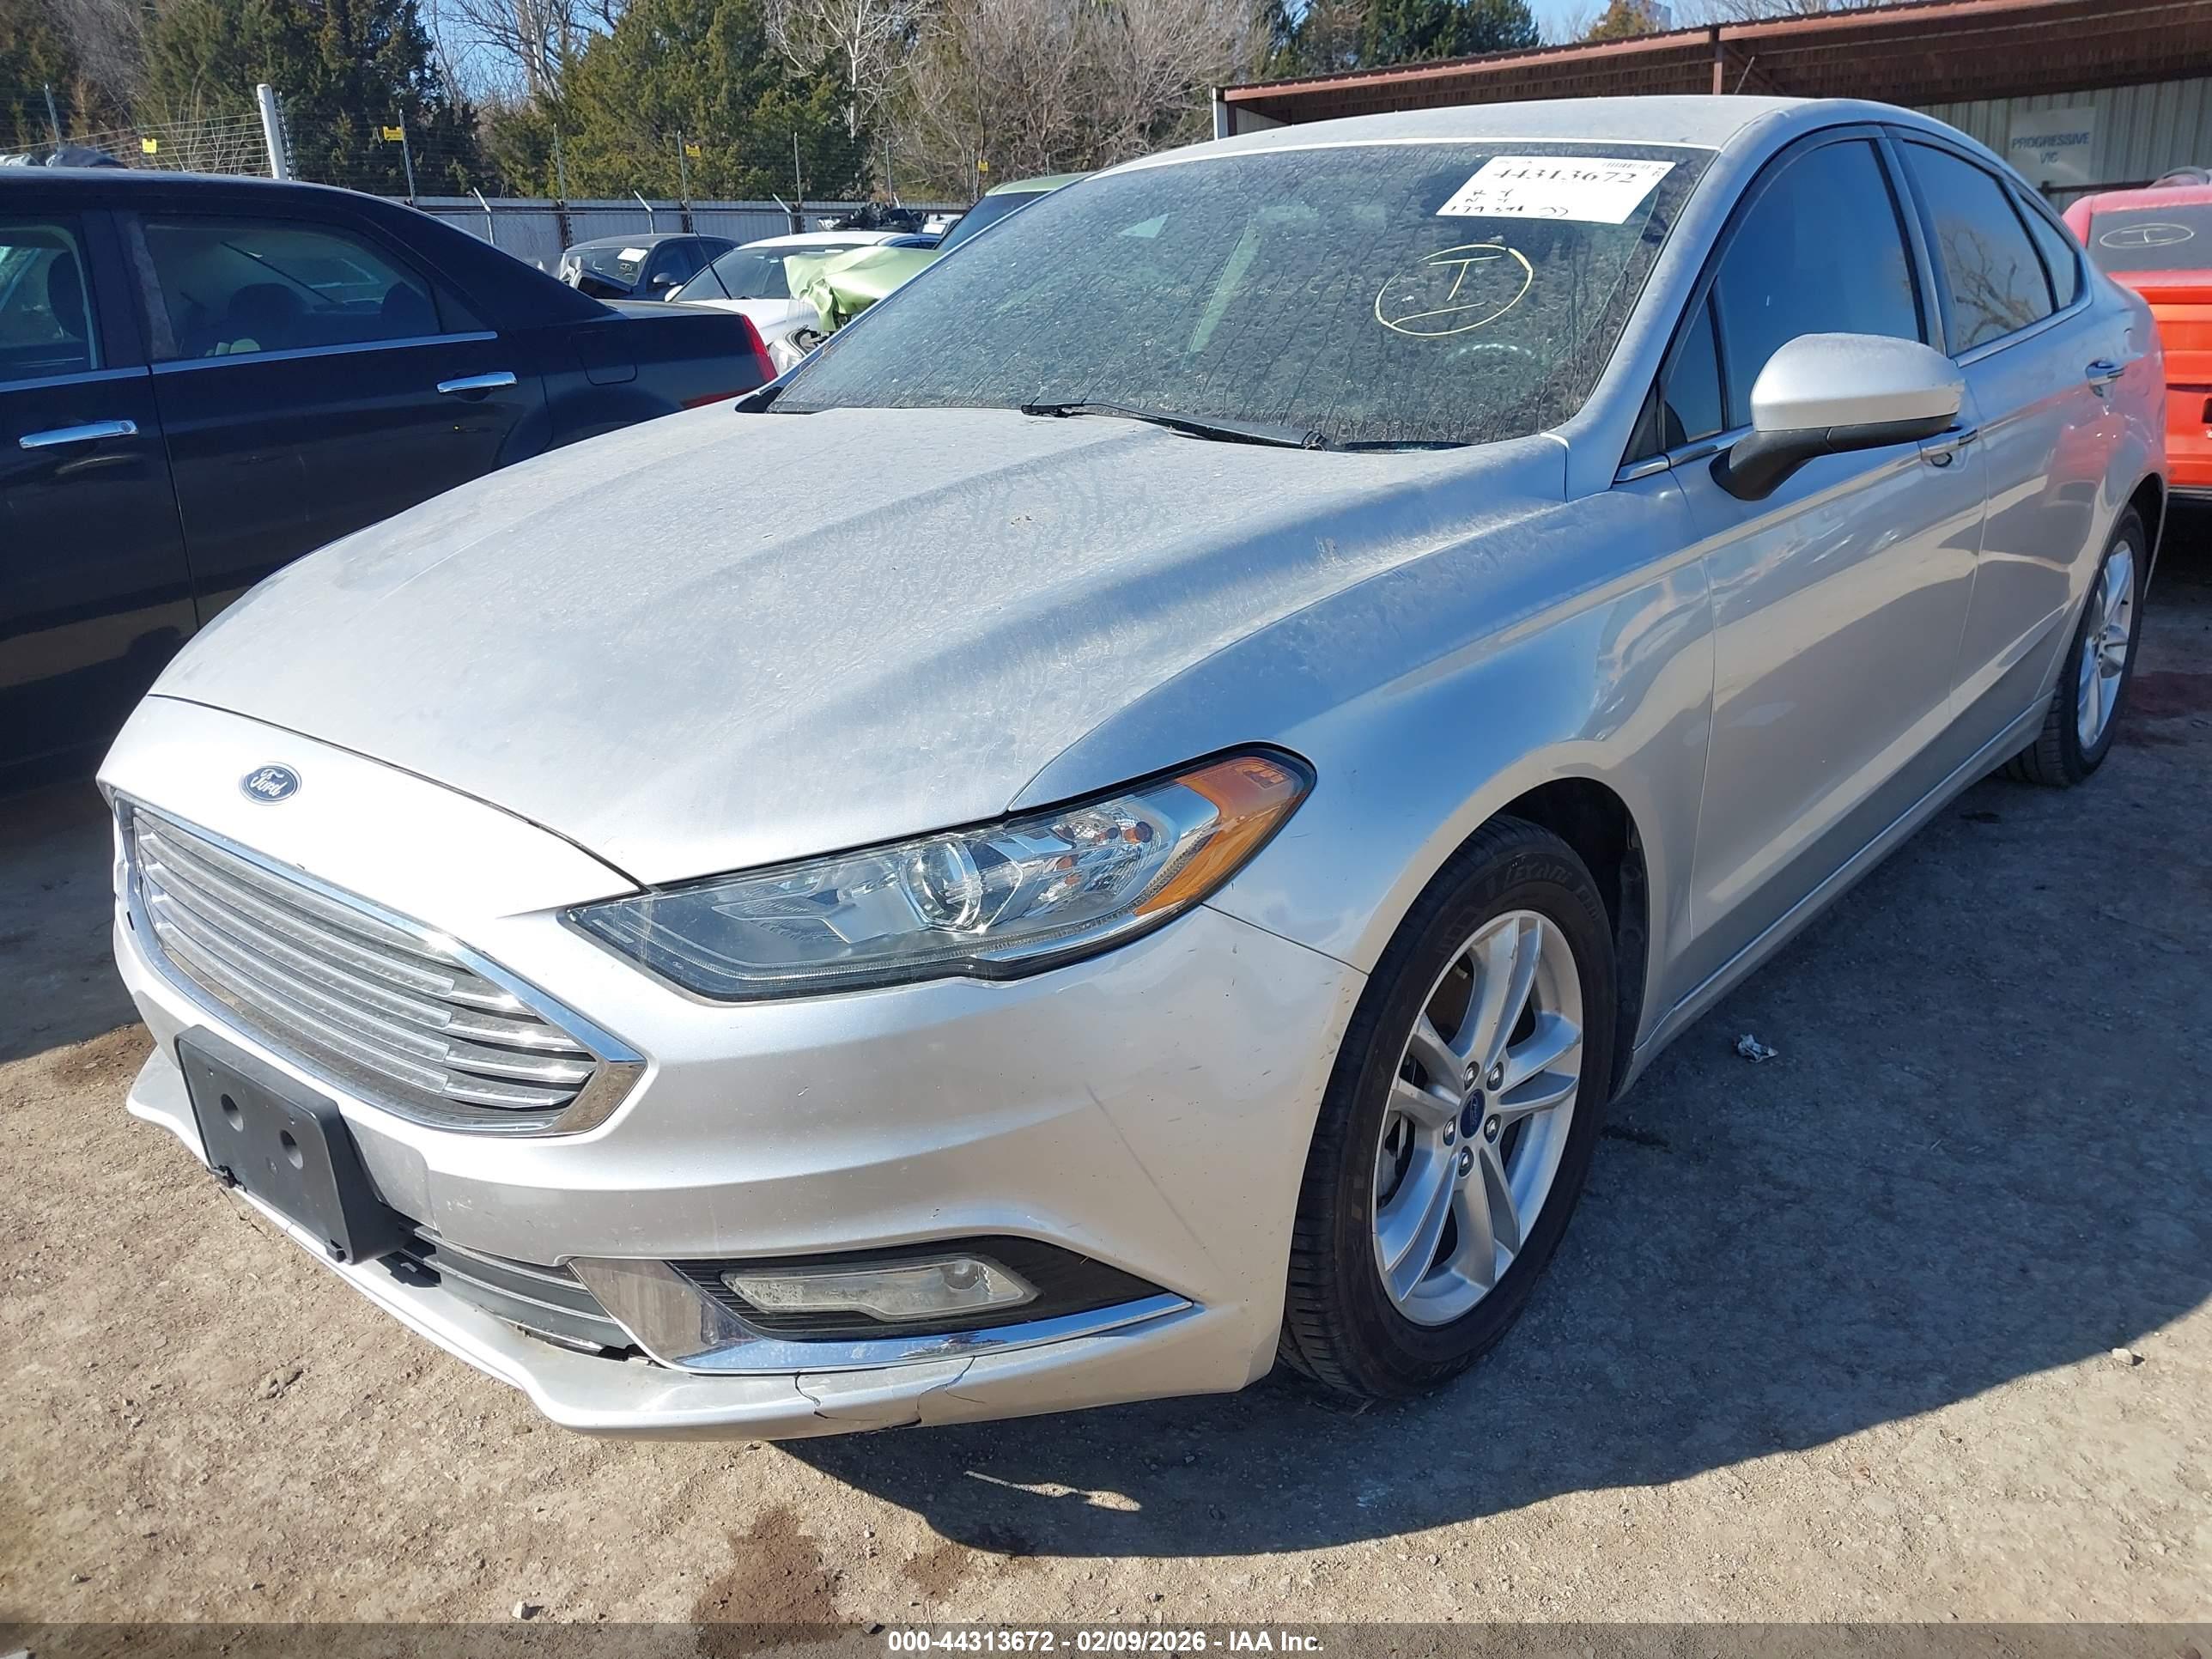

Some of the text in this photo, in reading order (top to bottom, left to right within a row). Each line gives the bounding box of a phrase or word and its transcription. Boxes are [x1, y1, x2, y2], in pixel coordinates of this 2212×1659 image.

[2012, 132, 2088, 149] PROGRESSIVE
[2040, 151, 2058, 165] VIC
[1493, 168, 1638, 184] 44313672
[249, 768, 289, 797] Ford
